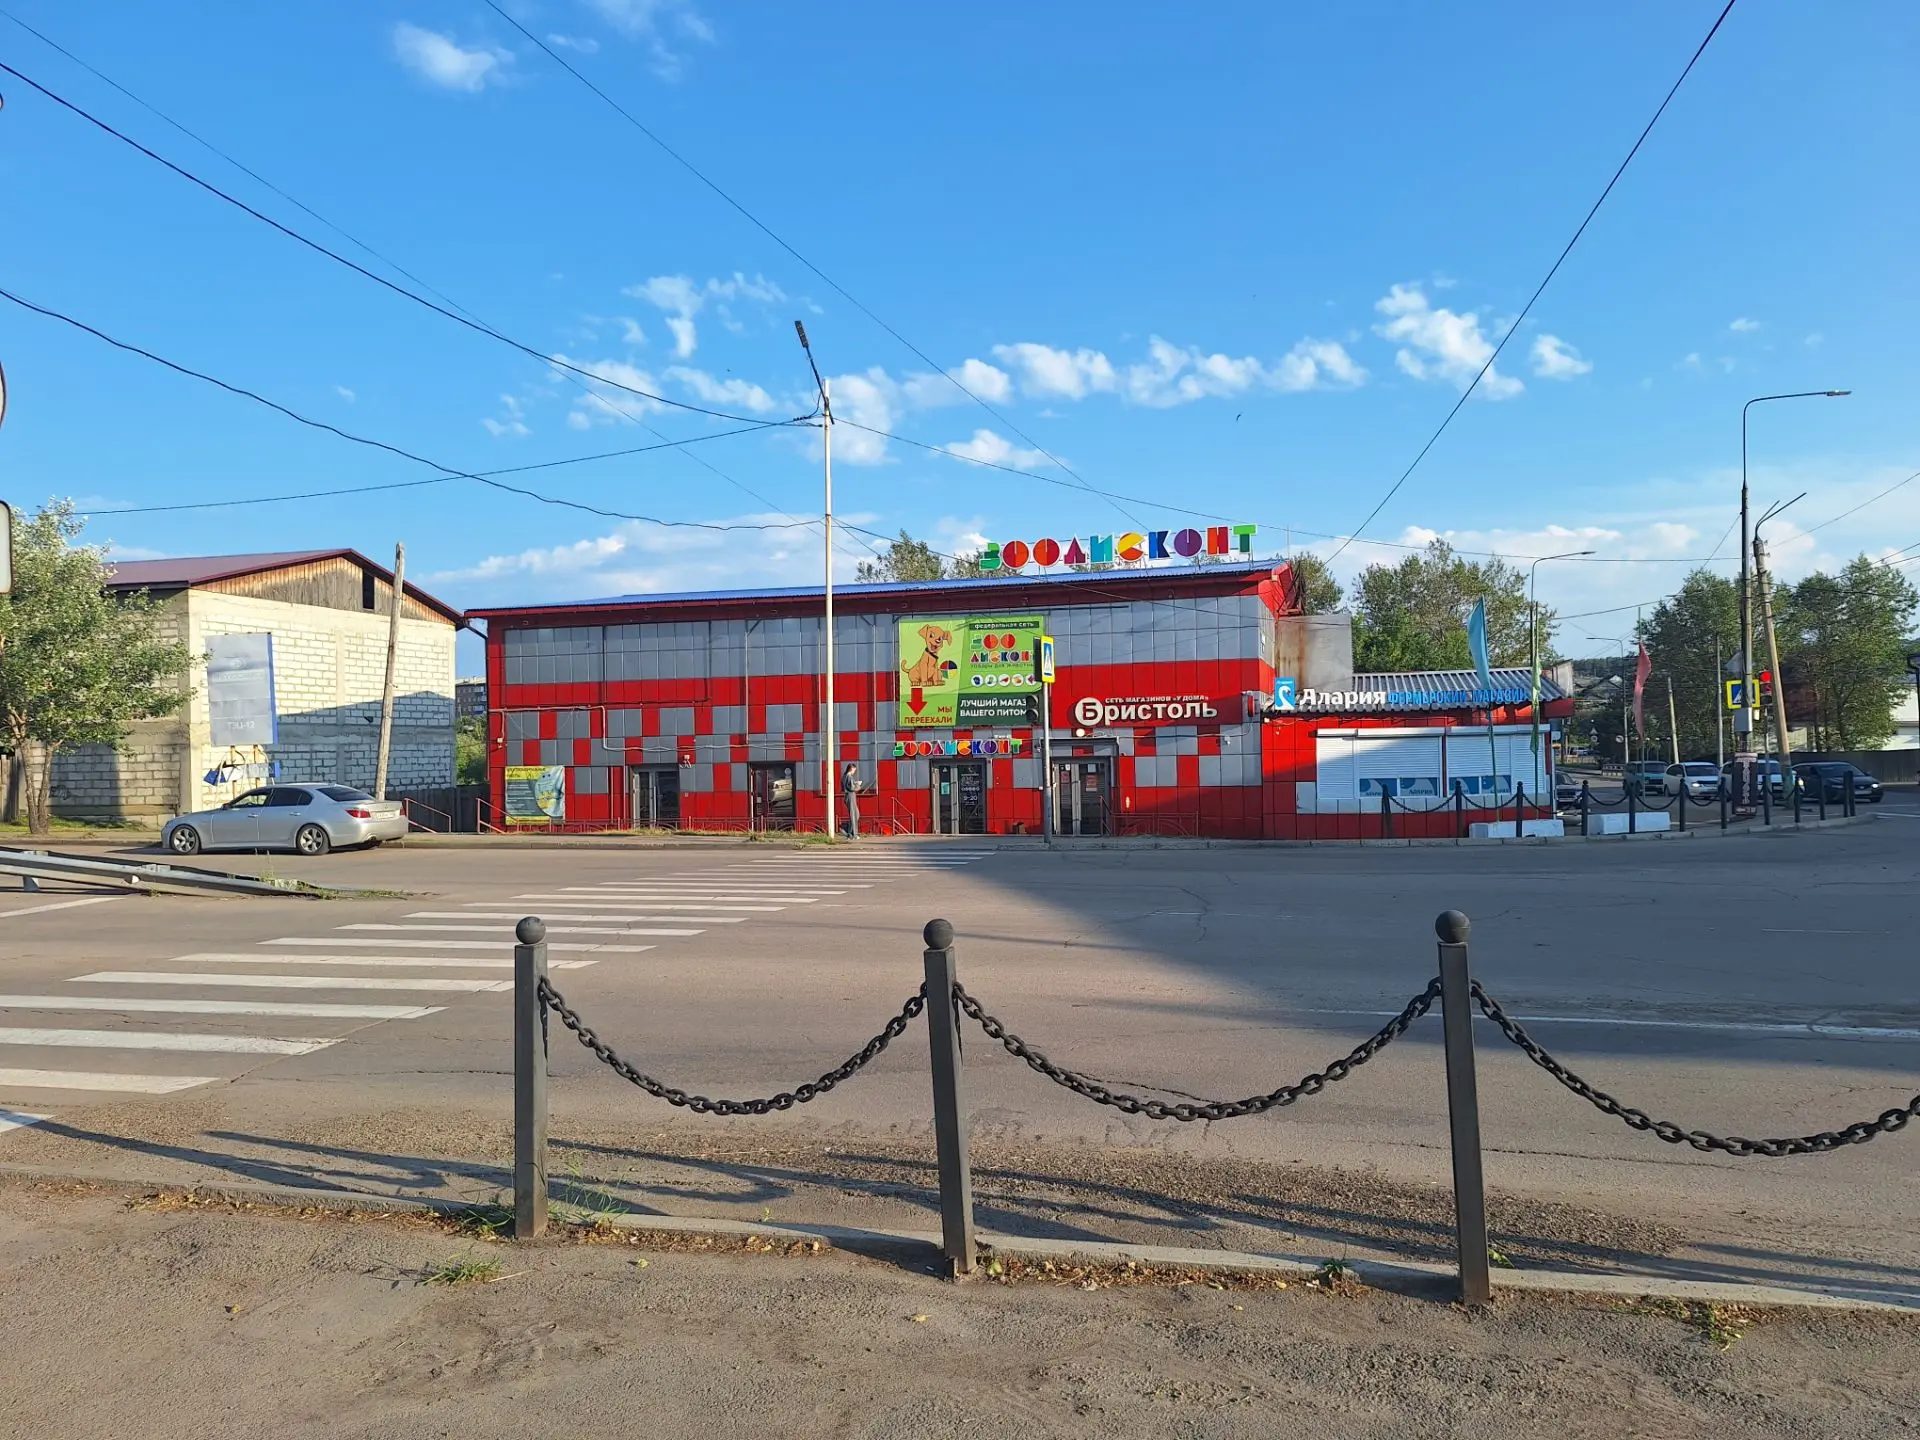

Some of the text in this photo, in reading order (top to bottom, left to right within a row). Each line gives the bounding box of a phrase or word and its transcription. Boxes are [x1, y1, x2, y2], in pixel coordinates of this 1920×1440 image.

[979, 524, 1257, 571] ЗООДИСКОНТ
[970, 632, 1017, 651] ЗОО
[970, 650, 1034, 664] ДИСКОН
[960, 697, 1027, 707] ЛУЧШИЙ МАГАЗ
[1299, 688, 1387, 709] Алария
[904, 716, 953, 724] ПЕРЕЕХАЛИ
[959, 708, 1027, 717] ВАШЕГО ПИТОМ
[1079, 698, 1218, 726] Бристоль
[893, 739, 1022, 757] ЗООДИСКОНТ
